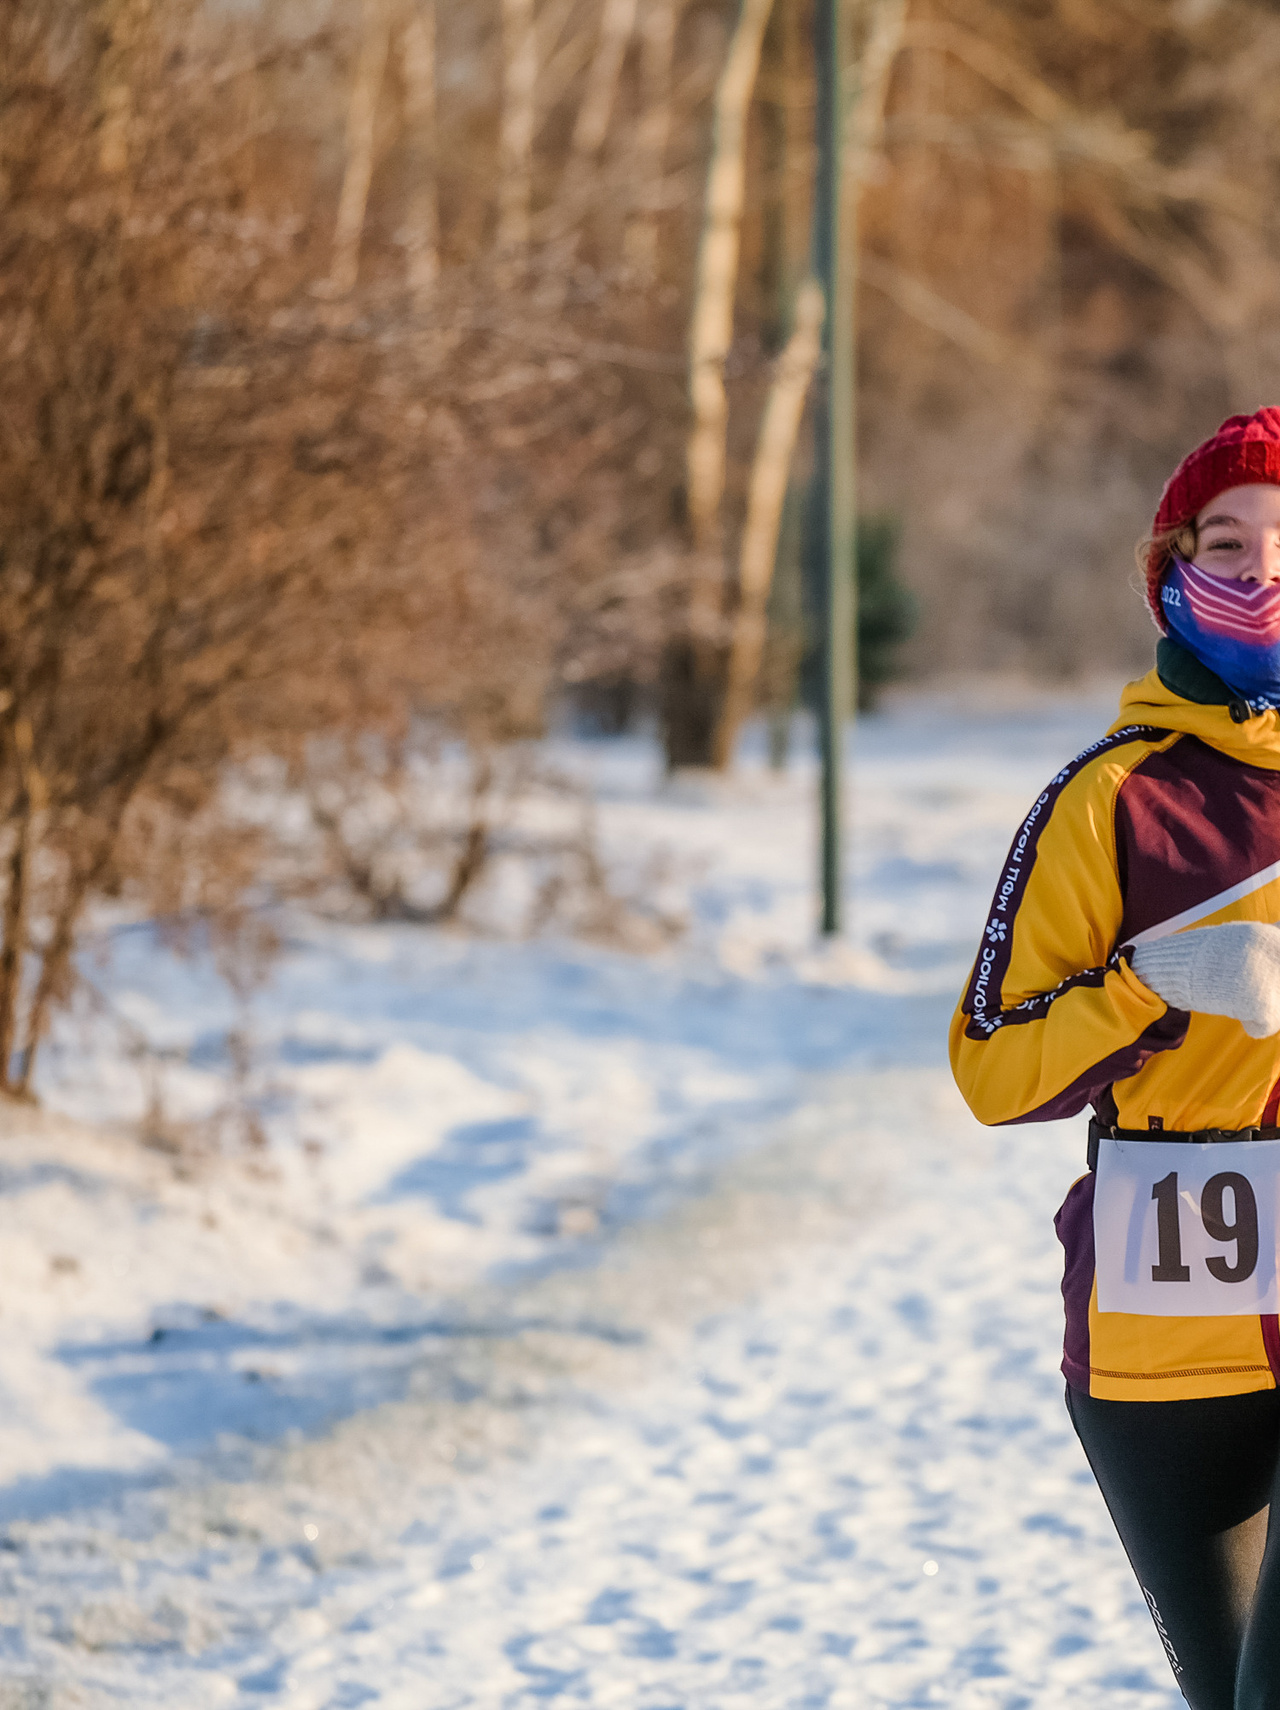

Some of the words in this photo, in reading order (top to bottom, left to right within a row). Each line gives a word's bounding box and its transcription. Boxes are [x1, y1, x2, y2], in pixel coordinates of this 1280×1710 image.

[996, 867, 1020, 911] МФЦ
[1012, 792, 1049, 862] ПОЛЮС
[973, 947, 997, 1008] ОЛЮС
[1151, 1171, 1259, 1283] 19
